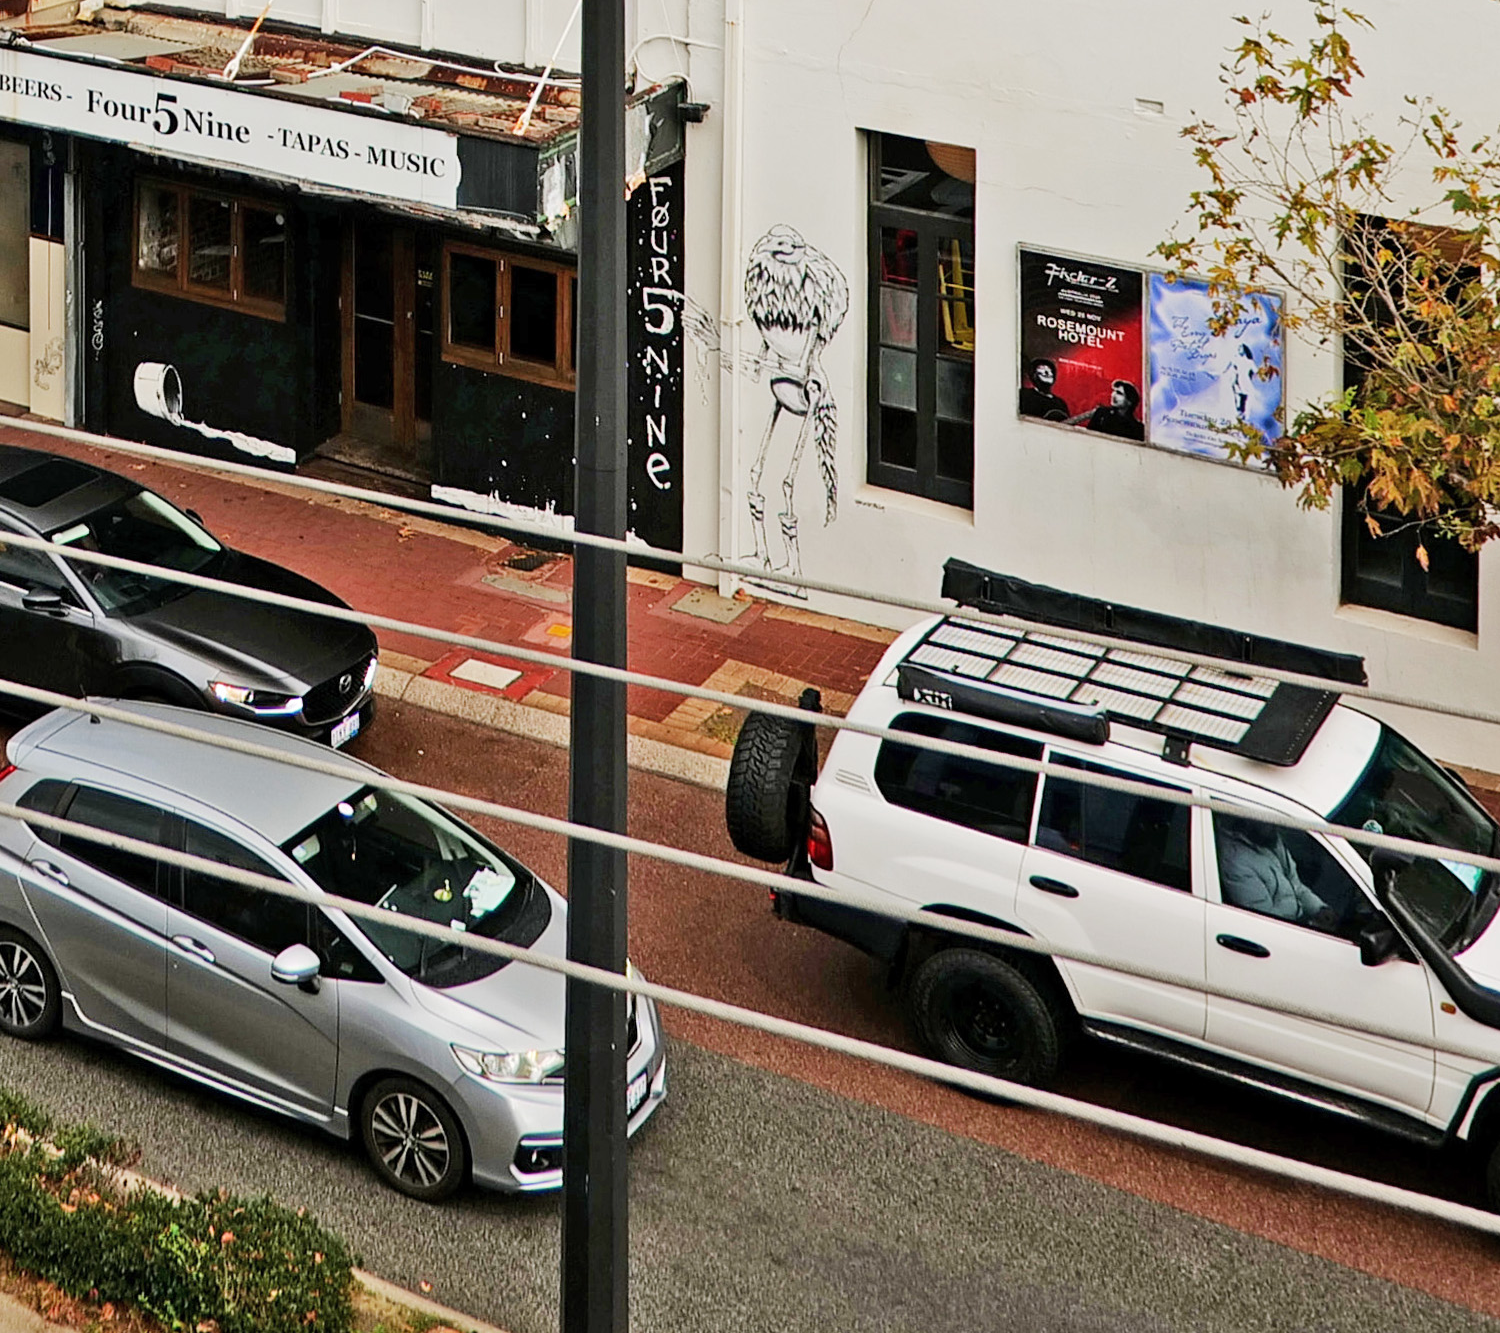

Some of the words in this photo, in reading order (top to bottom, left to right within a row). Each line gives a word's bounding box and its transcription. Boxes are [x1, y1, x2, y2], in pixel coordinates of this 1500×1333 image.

[278, 127, 350, 160] TAPAS
[366, 144, 446, 178] MUSIC
[1036, 314, 1126, 342] ROSEMOUNT
[1058, 330, 1104, 349] HOTEL
